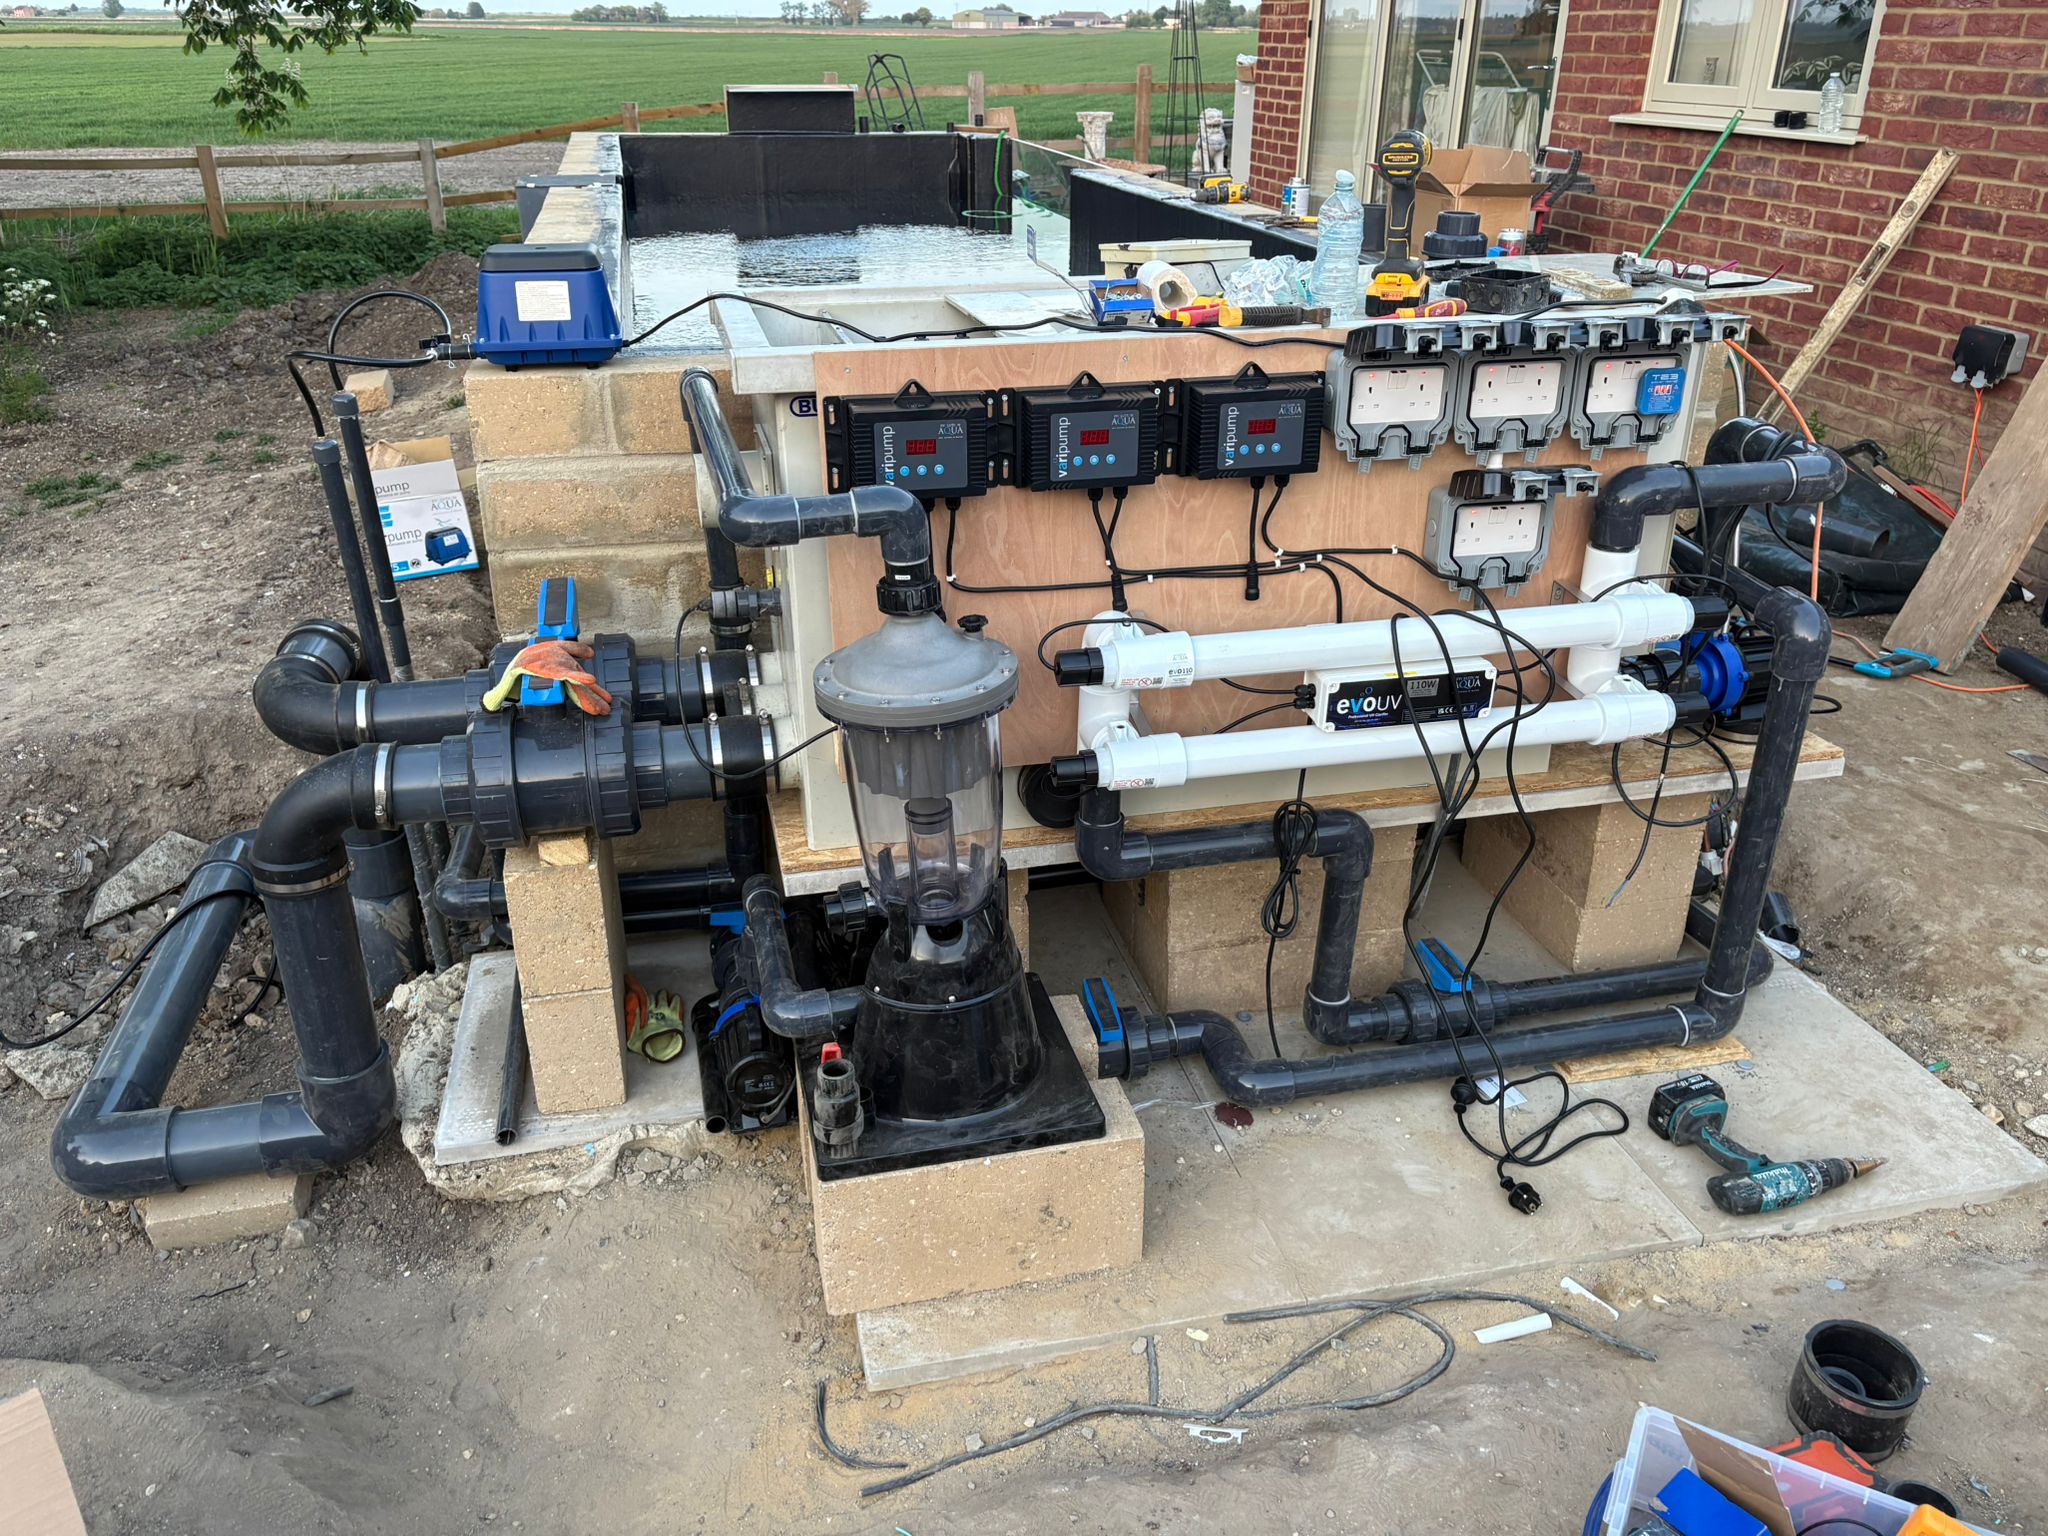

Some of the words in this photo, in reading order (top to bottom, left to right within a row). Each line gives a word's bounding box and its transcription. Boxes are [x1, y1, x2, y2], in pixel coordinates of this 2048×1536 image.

[1278, 405, 1303, 416] AQUA
[1111, 416, 1136, 426] AQUA
[938, 428, 964, 436] AQUA
[1222, 405, 1240, 467] varipump
[1056, 416, 1071, 478] varipump
[431, 499, 462, 511] AQUA
[1410, 680, 1437, 690] 110W
[1336, 694, 1403, 715] evoUV
[1752, 1166, 1793, 1181] makita
